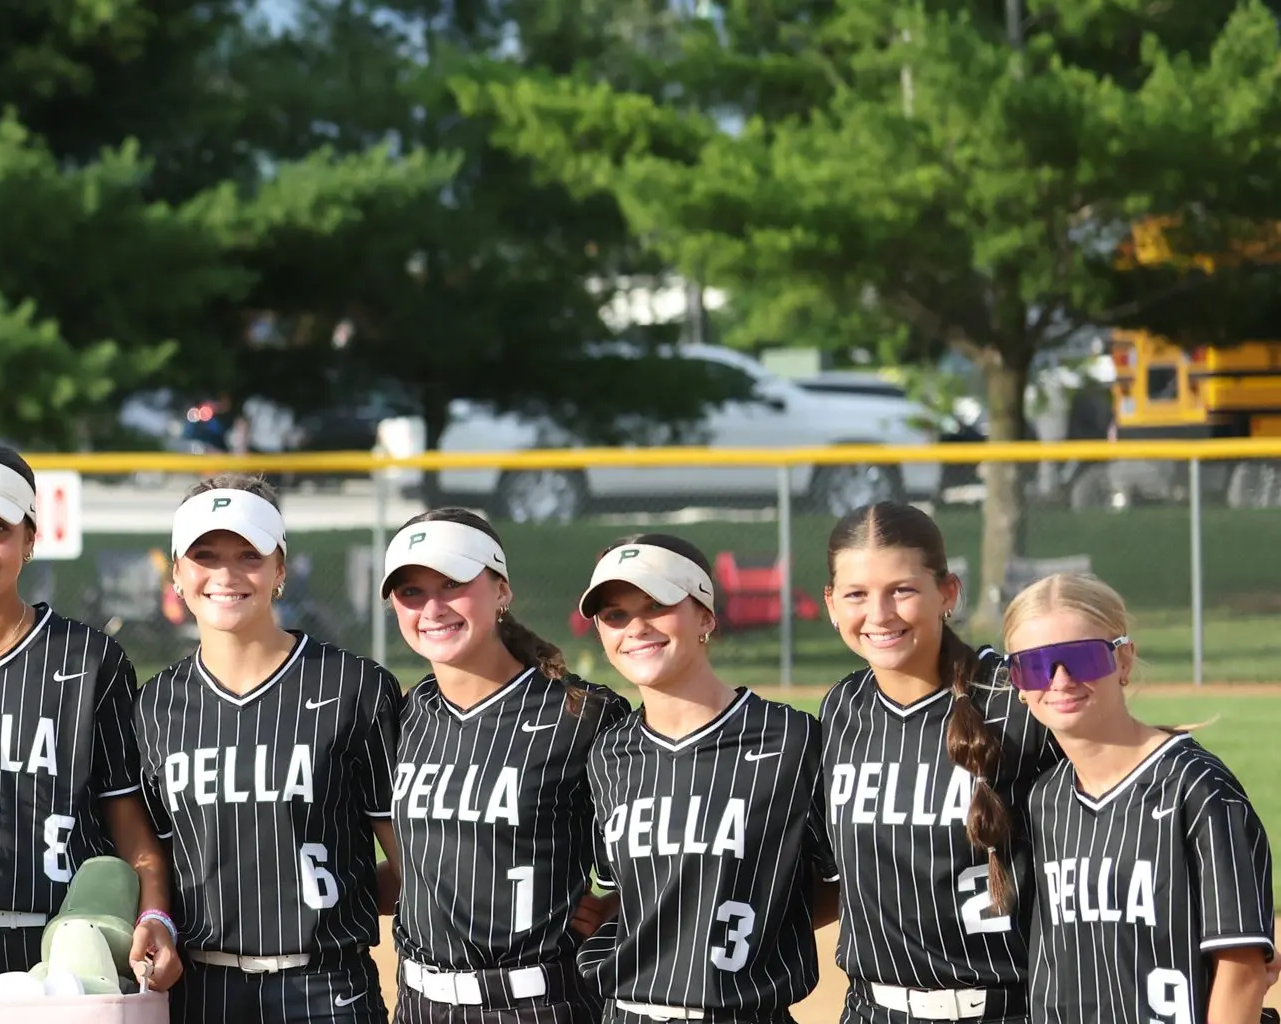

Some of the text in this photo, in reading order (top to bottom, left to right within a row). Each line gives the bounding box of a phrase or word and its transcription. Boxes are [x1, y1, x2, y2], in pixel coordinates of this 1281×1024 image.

[211, 497, 232, 512] P
[409, 532, 426, 550] P
[618, 548, 640, 564] P
[165, 744, 315, 813] PELLA
[391, 763, 520, 827] PELLA
[830, 762, 973, 827] PELLA
[43, 813, 76, 884] 8
[604, 795, 746, 863] PELLA
[300, 842, 340, 910] 6
[507, 866, 535, 933] 1
[957, 863, 1012, 935] 2
[1044, 857, 1157, 927] PELLA
[710, 900, 756, 973] 3
